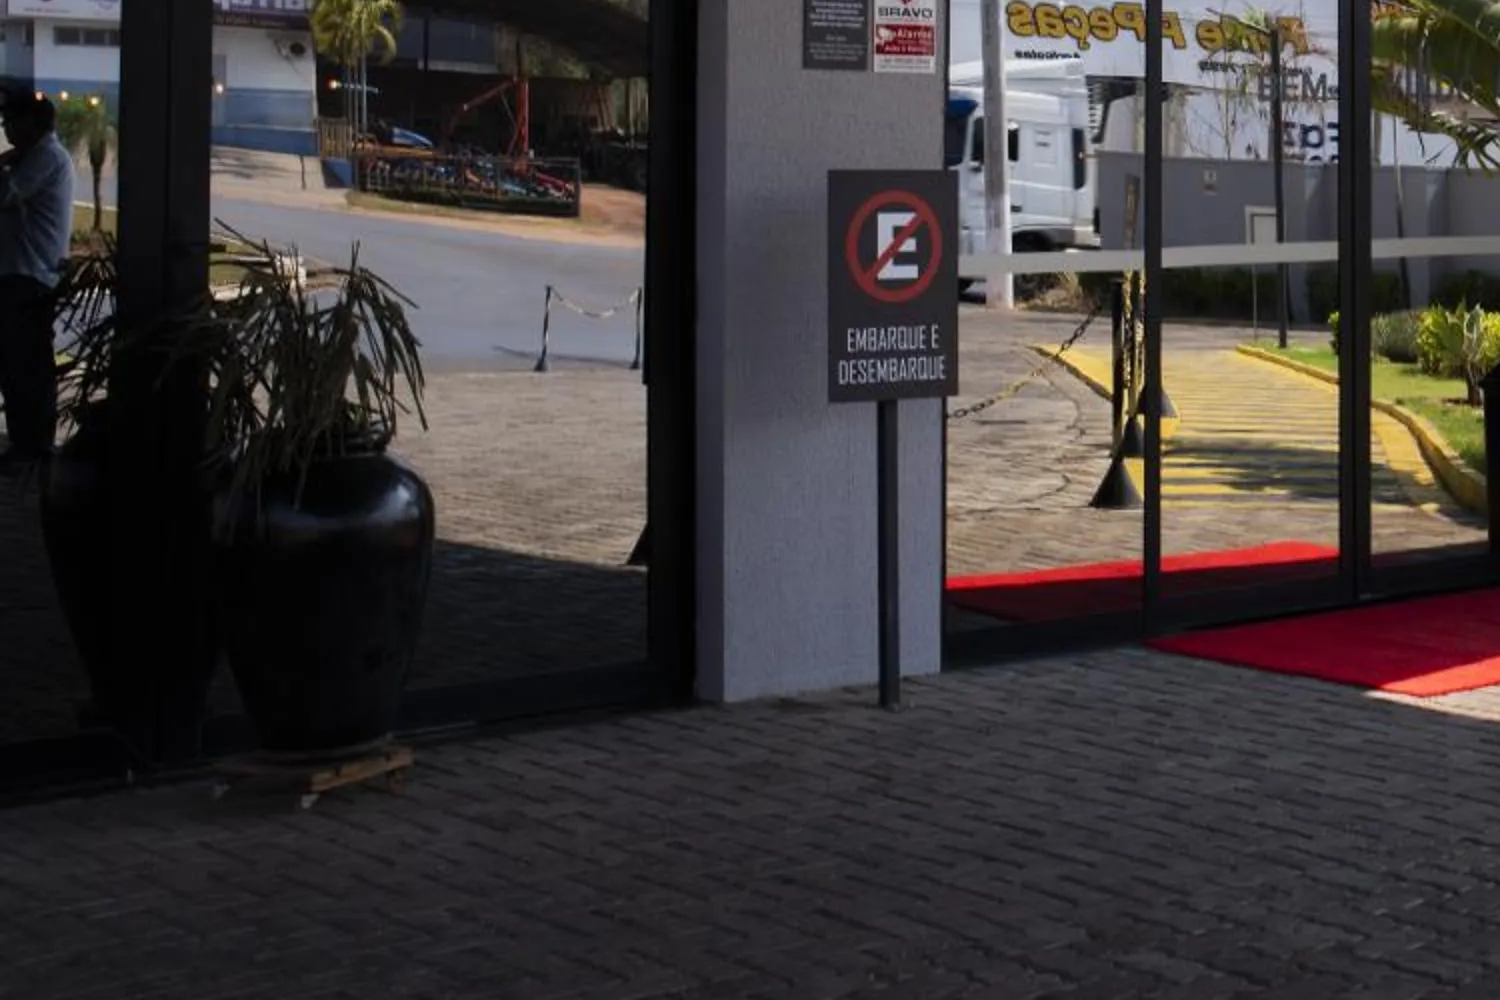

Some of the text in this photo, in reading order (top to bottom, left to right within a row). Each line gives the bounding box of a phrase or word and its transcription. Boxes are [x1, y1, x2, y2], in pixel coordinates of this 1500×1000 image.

[878, 7, 933, 18] BRAVO
[847, 325, 940, 353] EMBARQUE E
[838, 356, 946, 385] DESEMBARQUE
